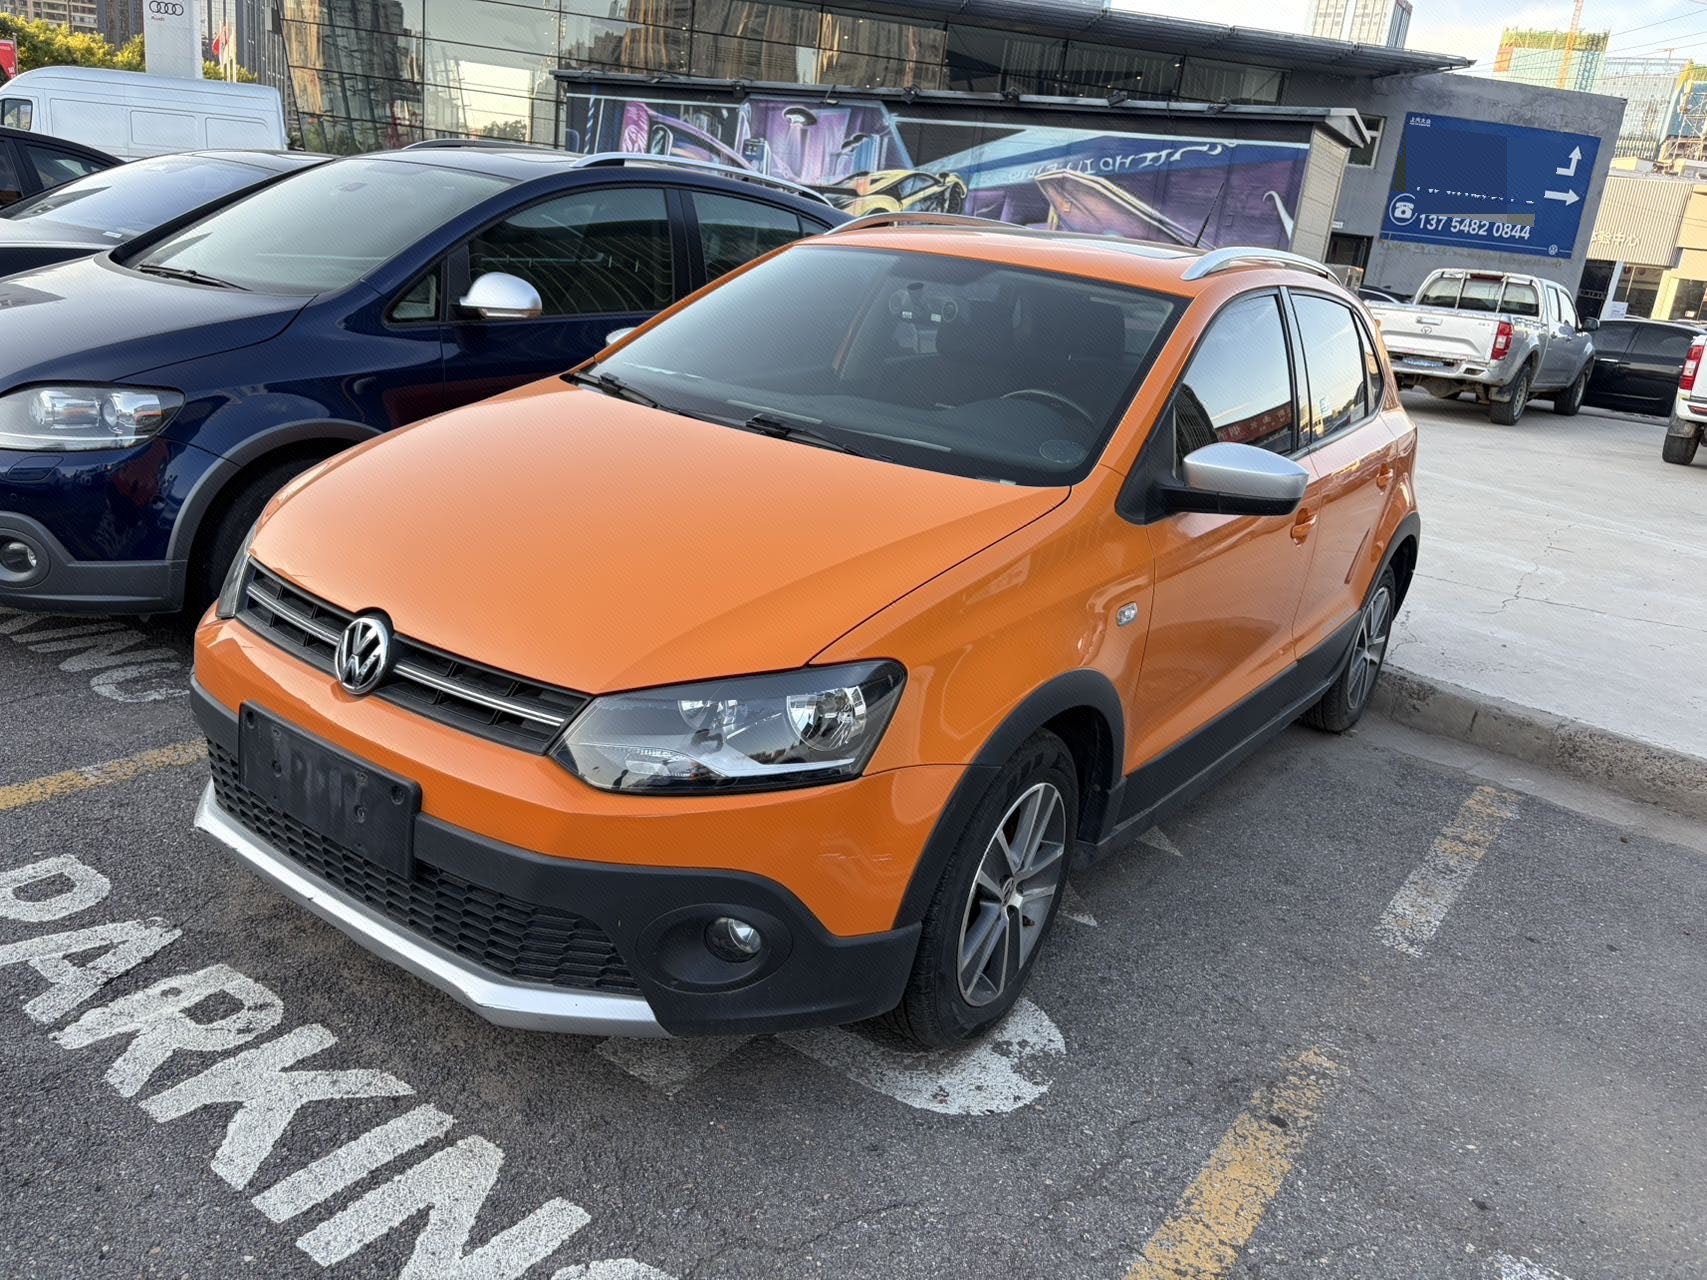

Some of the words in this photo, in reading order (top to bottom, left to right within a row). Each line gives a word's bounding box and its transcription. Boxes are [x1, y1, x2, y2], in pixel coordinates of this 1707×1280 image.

[1419, 214, 1445, 231] 137
[1450, 218, 1488, 236] 5482
[1493, 224, 1530, 240] 0844
[0, 854, 682, 1280] PARKIN
